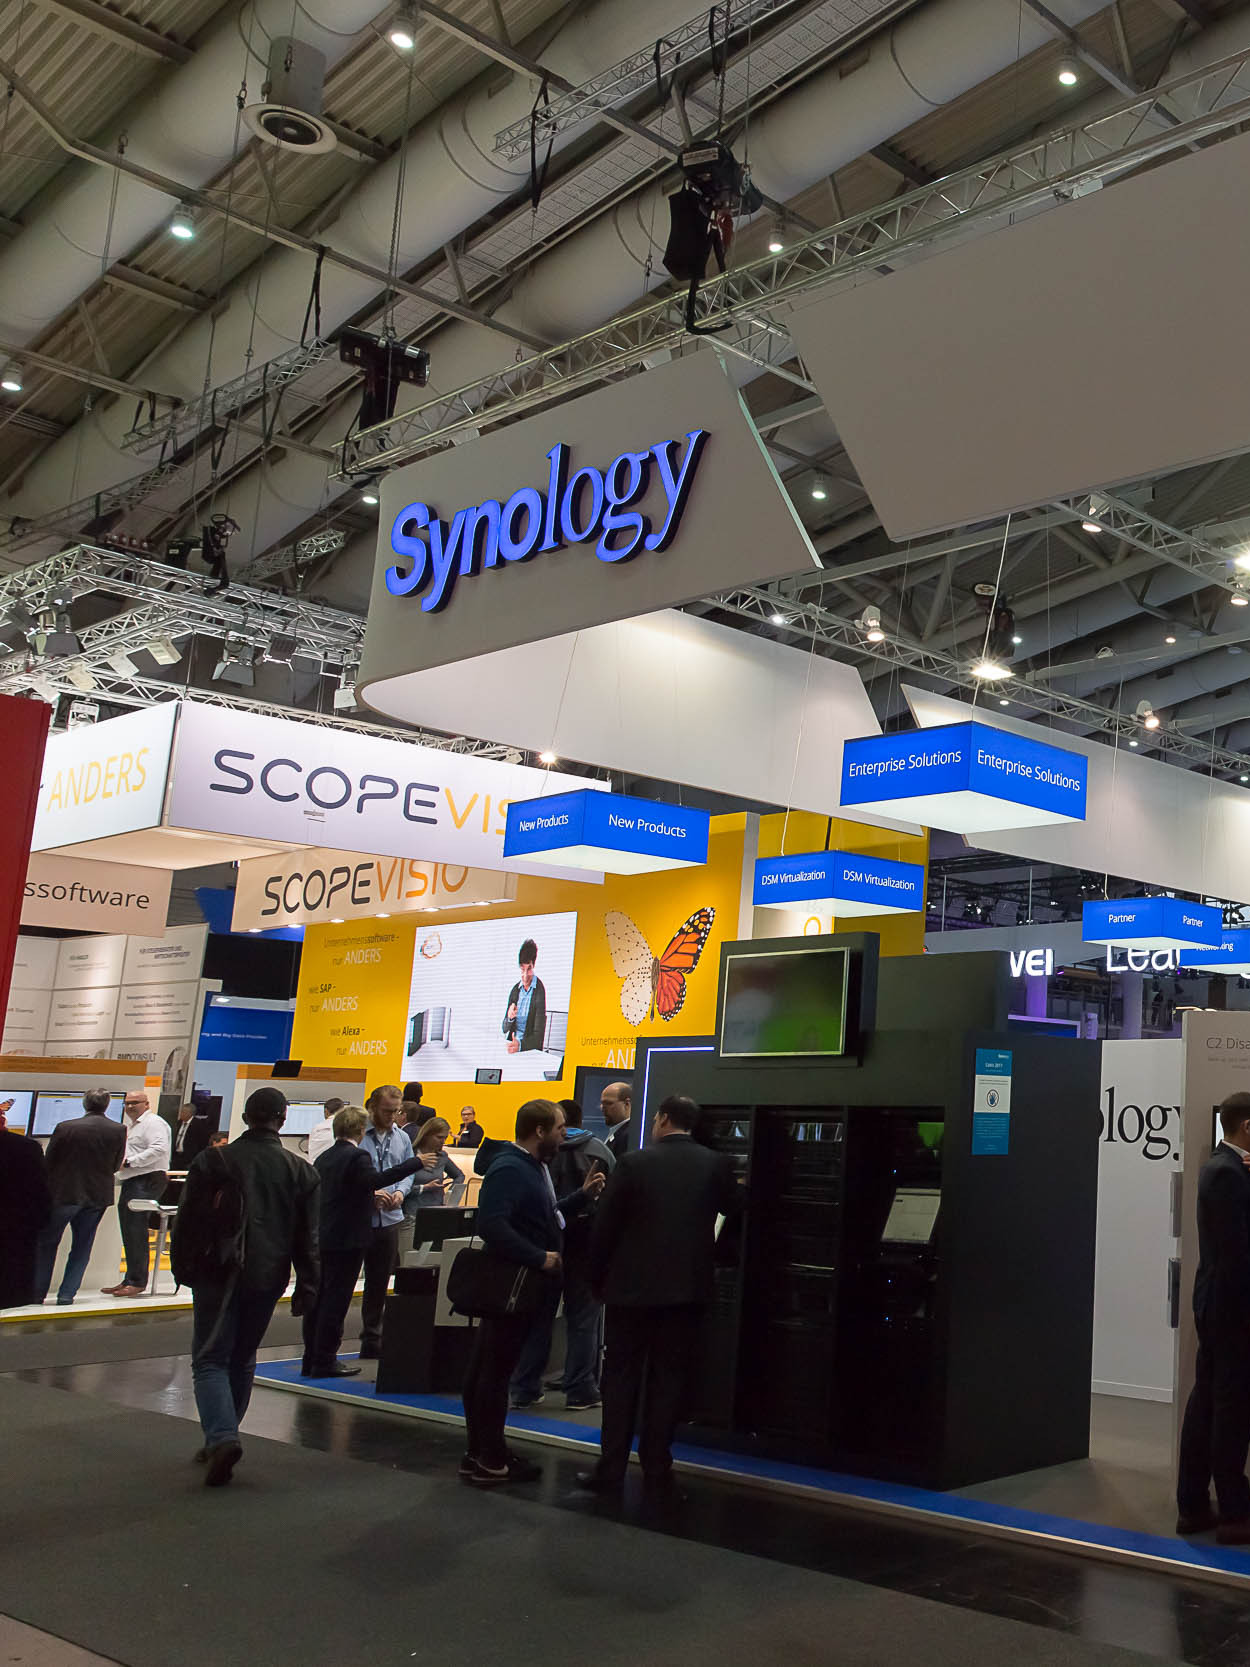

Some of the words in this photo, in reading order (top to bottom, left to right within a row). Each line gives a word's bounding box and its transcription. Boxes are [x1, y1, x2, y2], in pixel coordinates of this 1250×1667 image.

[385, 429, 708, 613] Synology
[849, 757, 905, 777] Enterprise
[908, 750, 962, 769] Solutions
[977, 750, 1032, 779] Enterprise
[1035, 766, 1081, 792] Solutions
[46, 747, 149, 812] ANDERS
[519, 819, 536, 832] New
[537, 813, 569, 830] Products
[608, 813, 634, 829] New
[637, 818, 687, 838] Products
[761, 874, 779, 885] DSM
[780, 870, 826, 884] Virtualization
[843, 869, 864, 882] DSM
[864, 873, 915, 891] Virtualization
[1108, 913, 1136, 924] Partner
[1182, 915, 1204, 928] Partner
[344, 948, 382, 965] ANDERS
[320, 983, 332, 993] SAP
[321, 996, 358, 1012] ANDERS
[342, 1026, 360, 1036] Alexa
[348, 1040, 388, 1056] ANDERS
[1206, 1037, 1222, 1049] C2
